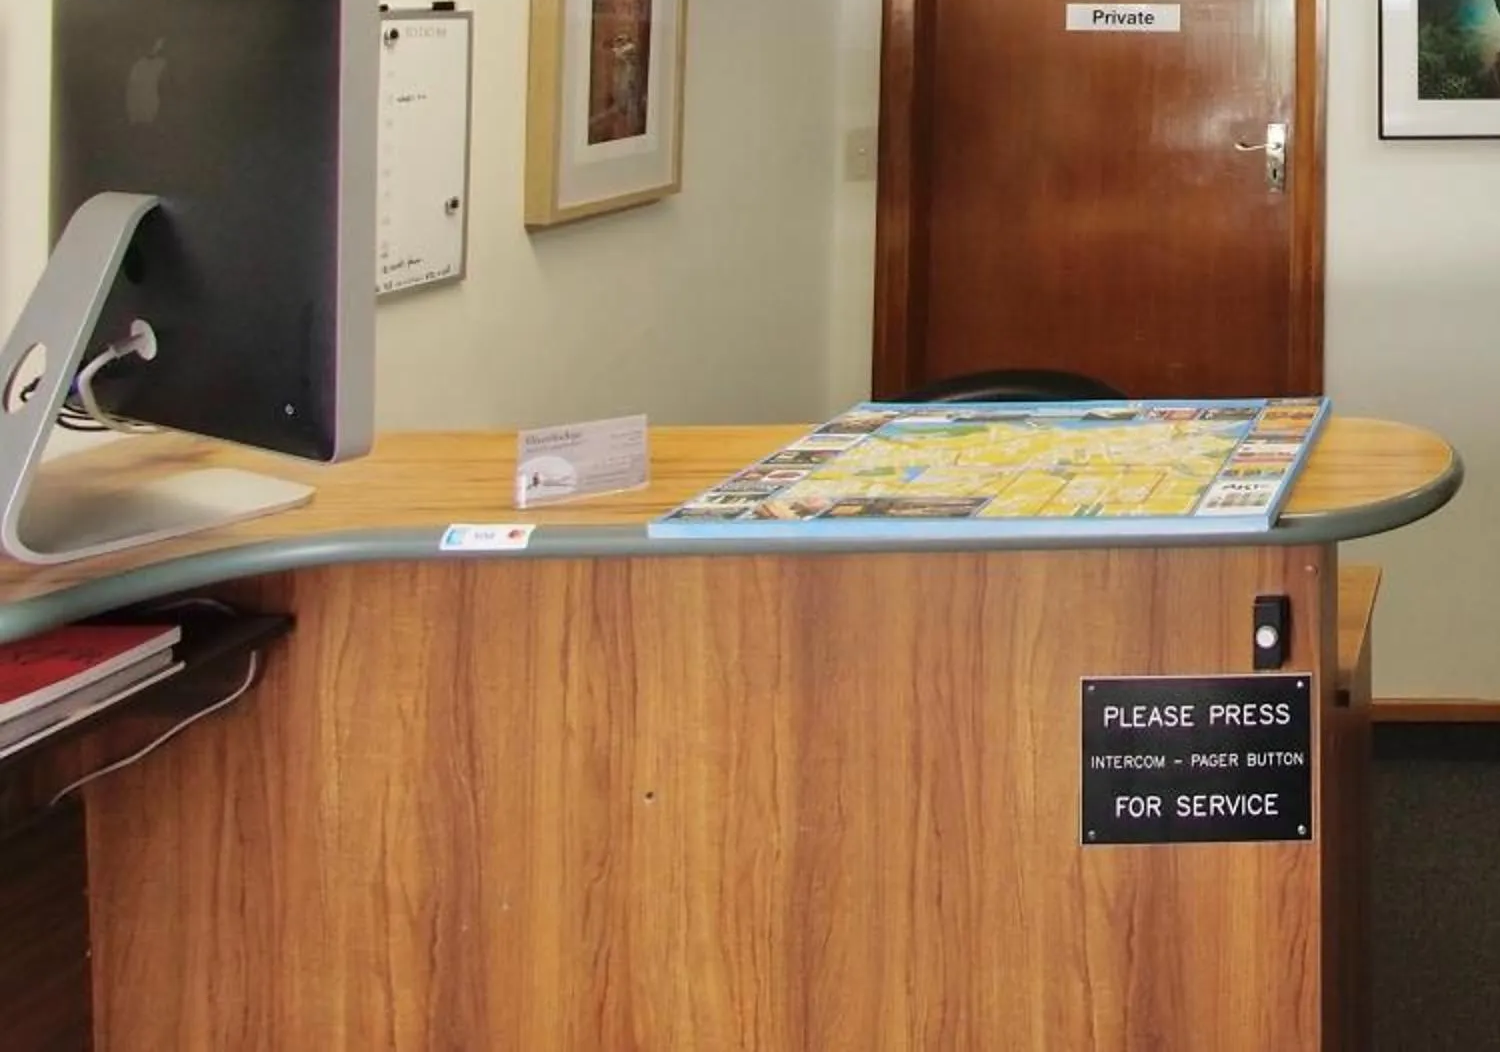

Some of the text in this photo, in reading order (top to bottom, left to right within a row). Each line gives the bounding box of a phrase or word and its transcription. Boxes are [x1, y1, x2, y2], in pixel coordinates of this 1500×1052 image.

[1092, 9, 1155, 26] Private
[1103, 703, 1291, 728] PLEASE PRESS
[1090, 754, 1166, 770] INTERCOM
[1190, 752, 1239, 768] PAGER
[1246, 751, 1305, 767] BUTTON
[1115, 793, 1280, 819] FOR SERVICE
